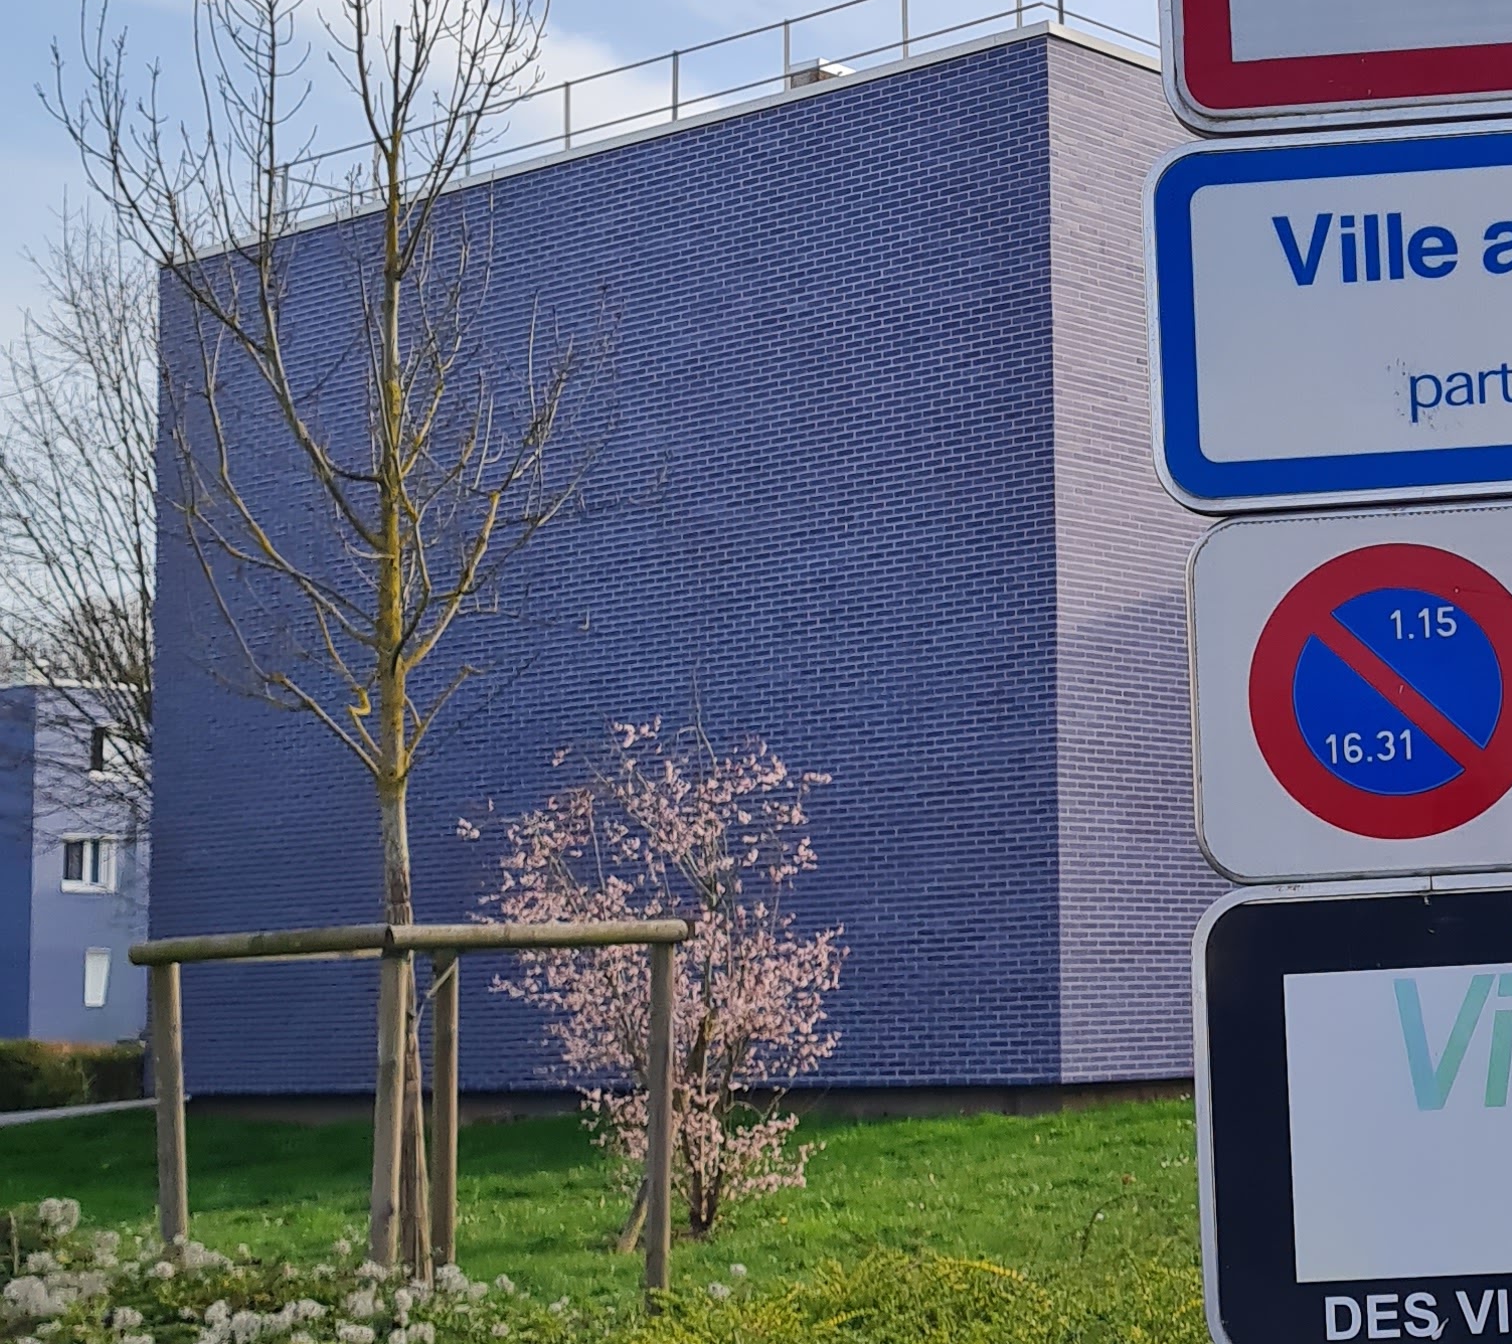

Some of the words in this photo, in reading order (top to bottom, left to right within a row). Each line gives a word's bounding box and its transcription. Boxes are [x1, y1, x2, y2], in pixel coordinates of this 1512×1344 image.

[1272, 213, 1458, 286] Ville
[1391, 607, 1456, 639] 1.15
[1326, 730, 1411, 763] 16.31
[1325, 1292, 1438, 1340] DES
